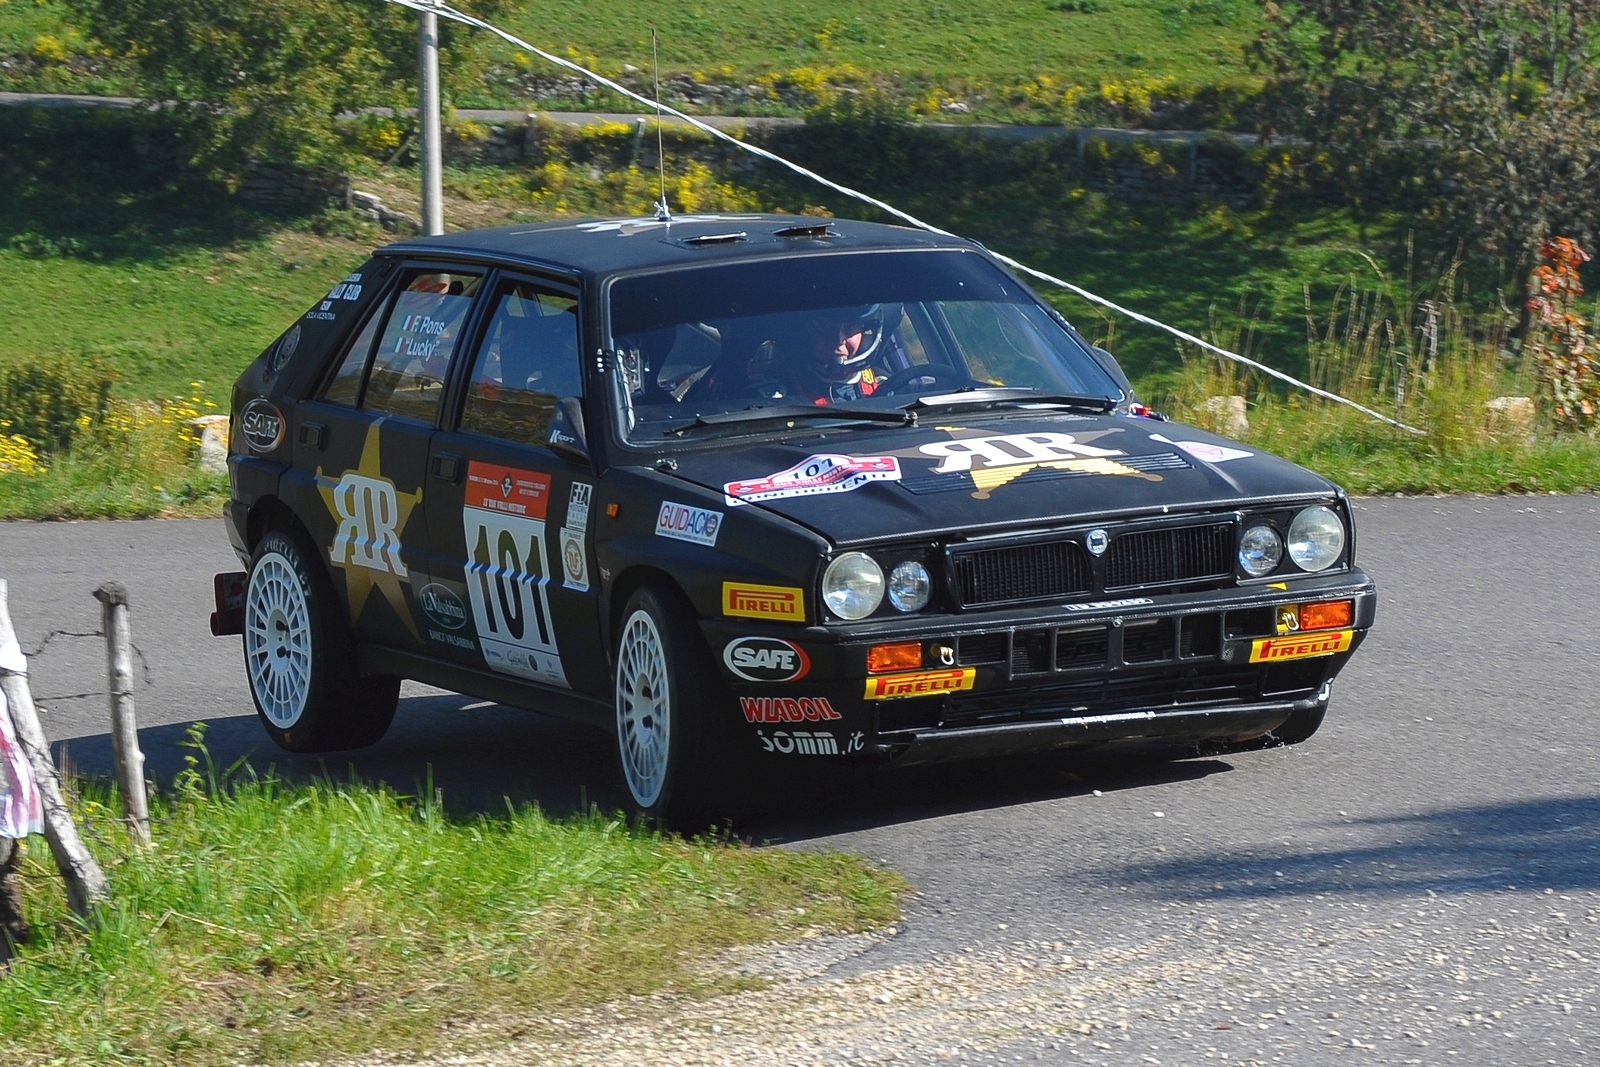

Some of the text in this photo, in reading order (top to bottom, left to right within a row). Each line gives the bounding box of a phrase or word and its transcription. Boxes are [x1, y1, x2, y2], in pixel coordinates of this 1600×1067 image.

[412, 315, 445, 335] F. Pons
[243, 411, 281, 439] SAFE
[788, 457, 835, 480] 101
[470, 523, 551, 647] 101
[729, 589, 796, 614] PIRELLI
[732, 647, 796, 671] SAFE
[1261, 633, 1342, 659] PIRELLI
[876, 670, 963, 696] PIRELLI
[739, 697, 843, 723] WLADOIL
